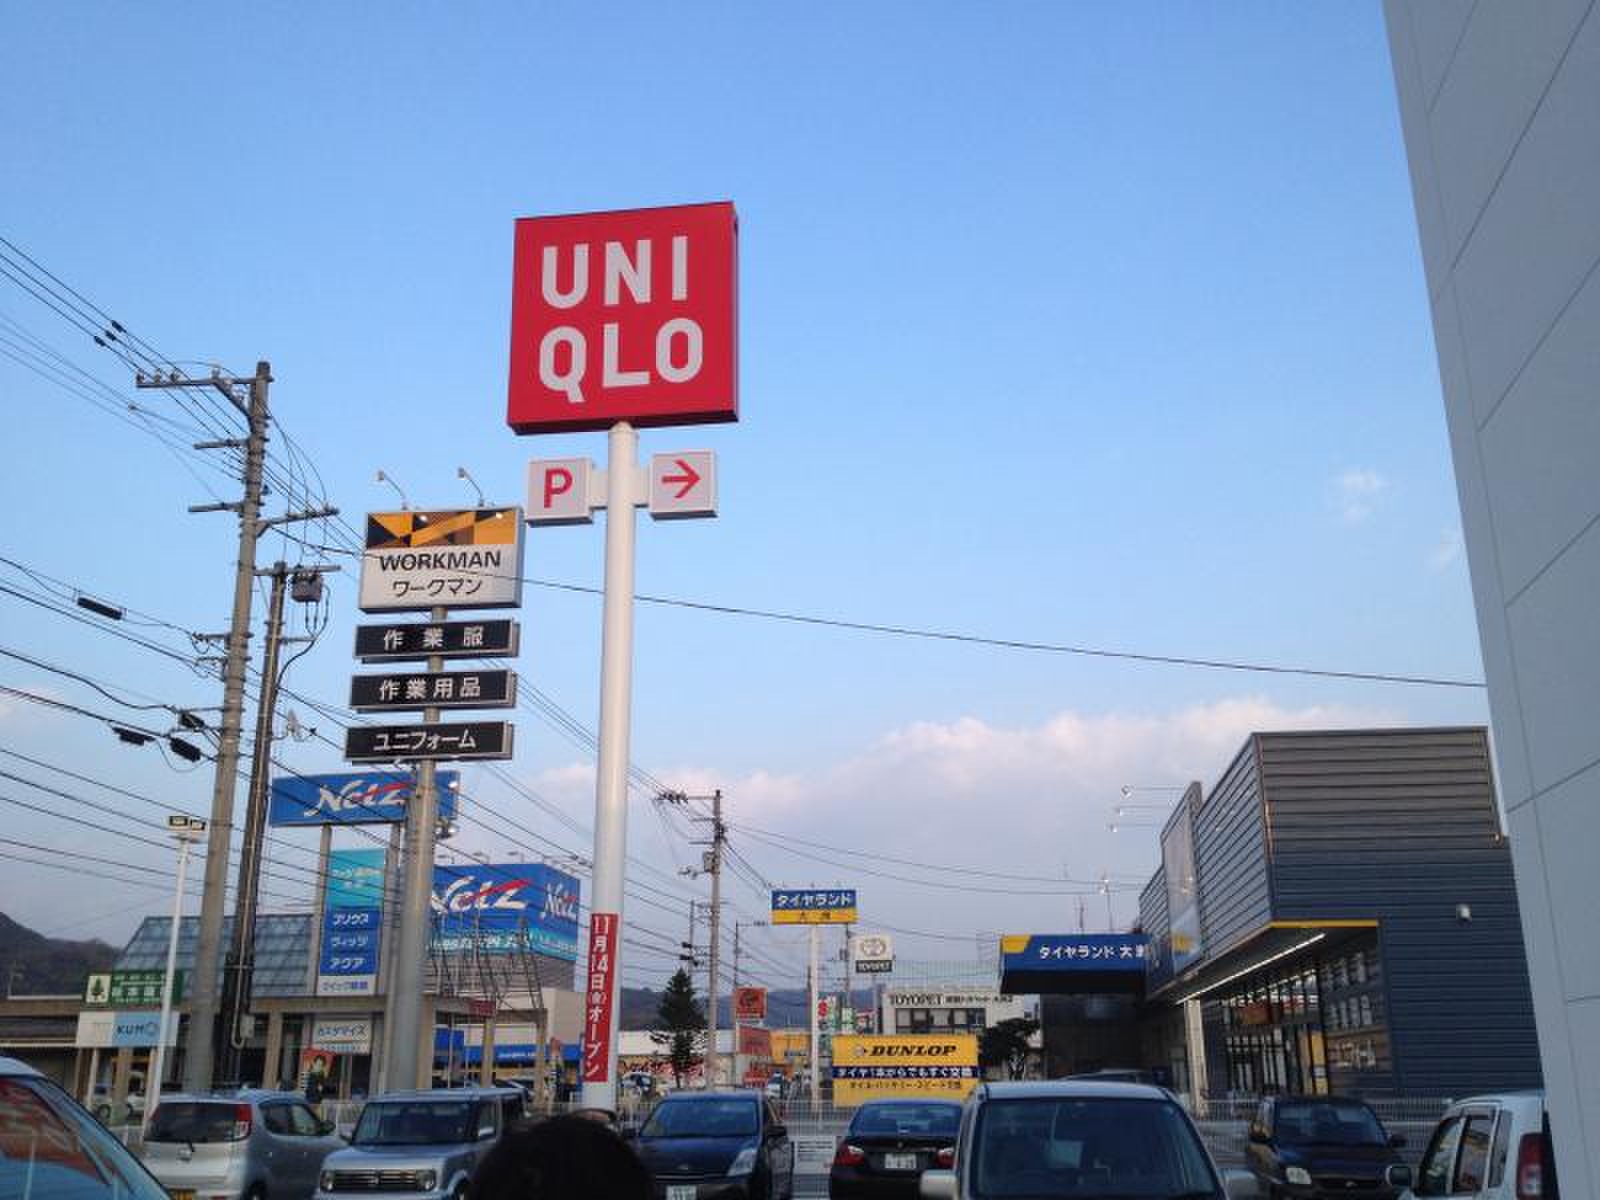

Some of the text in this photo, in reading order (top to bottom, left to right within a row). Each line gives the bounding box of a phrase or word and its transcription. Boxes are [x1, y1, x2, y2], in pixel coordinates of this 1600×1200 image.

[541, 235, 688, 309] UNI
[539, 317, 704, 404] QLO
[543, 468, 573, 509] P
[380, 550, 501, 571] WORKMAN
[392, 578, 482, 597] ワークマン
[383, 626, 484, 650] 作業服
[379, 677, 481, 701] 作業用品
[373, 729, 476, 751] ユニフォーム
[777, 893, 852, 907] タイヤランド
[1040, 944, 1115, 960] タイヤランド
[868, 1045, 957, 1057] DUNLOP
